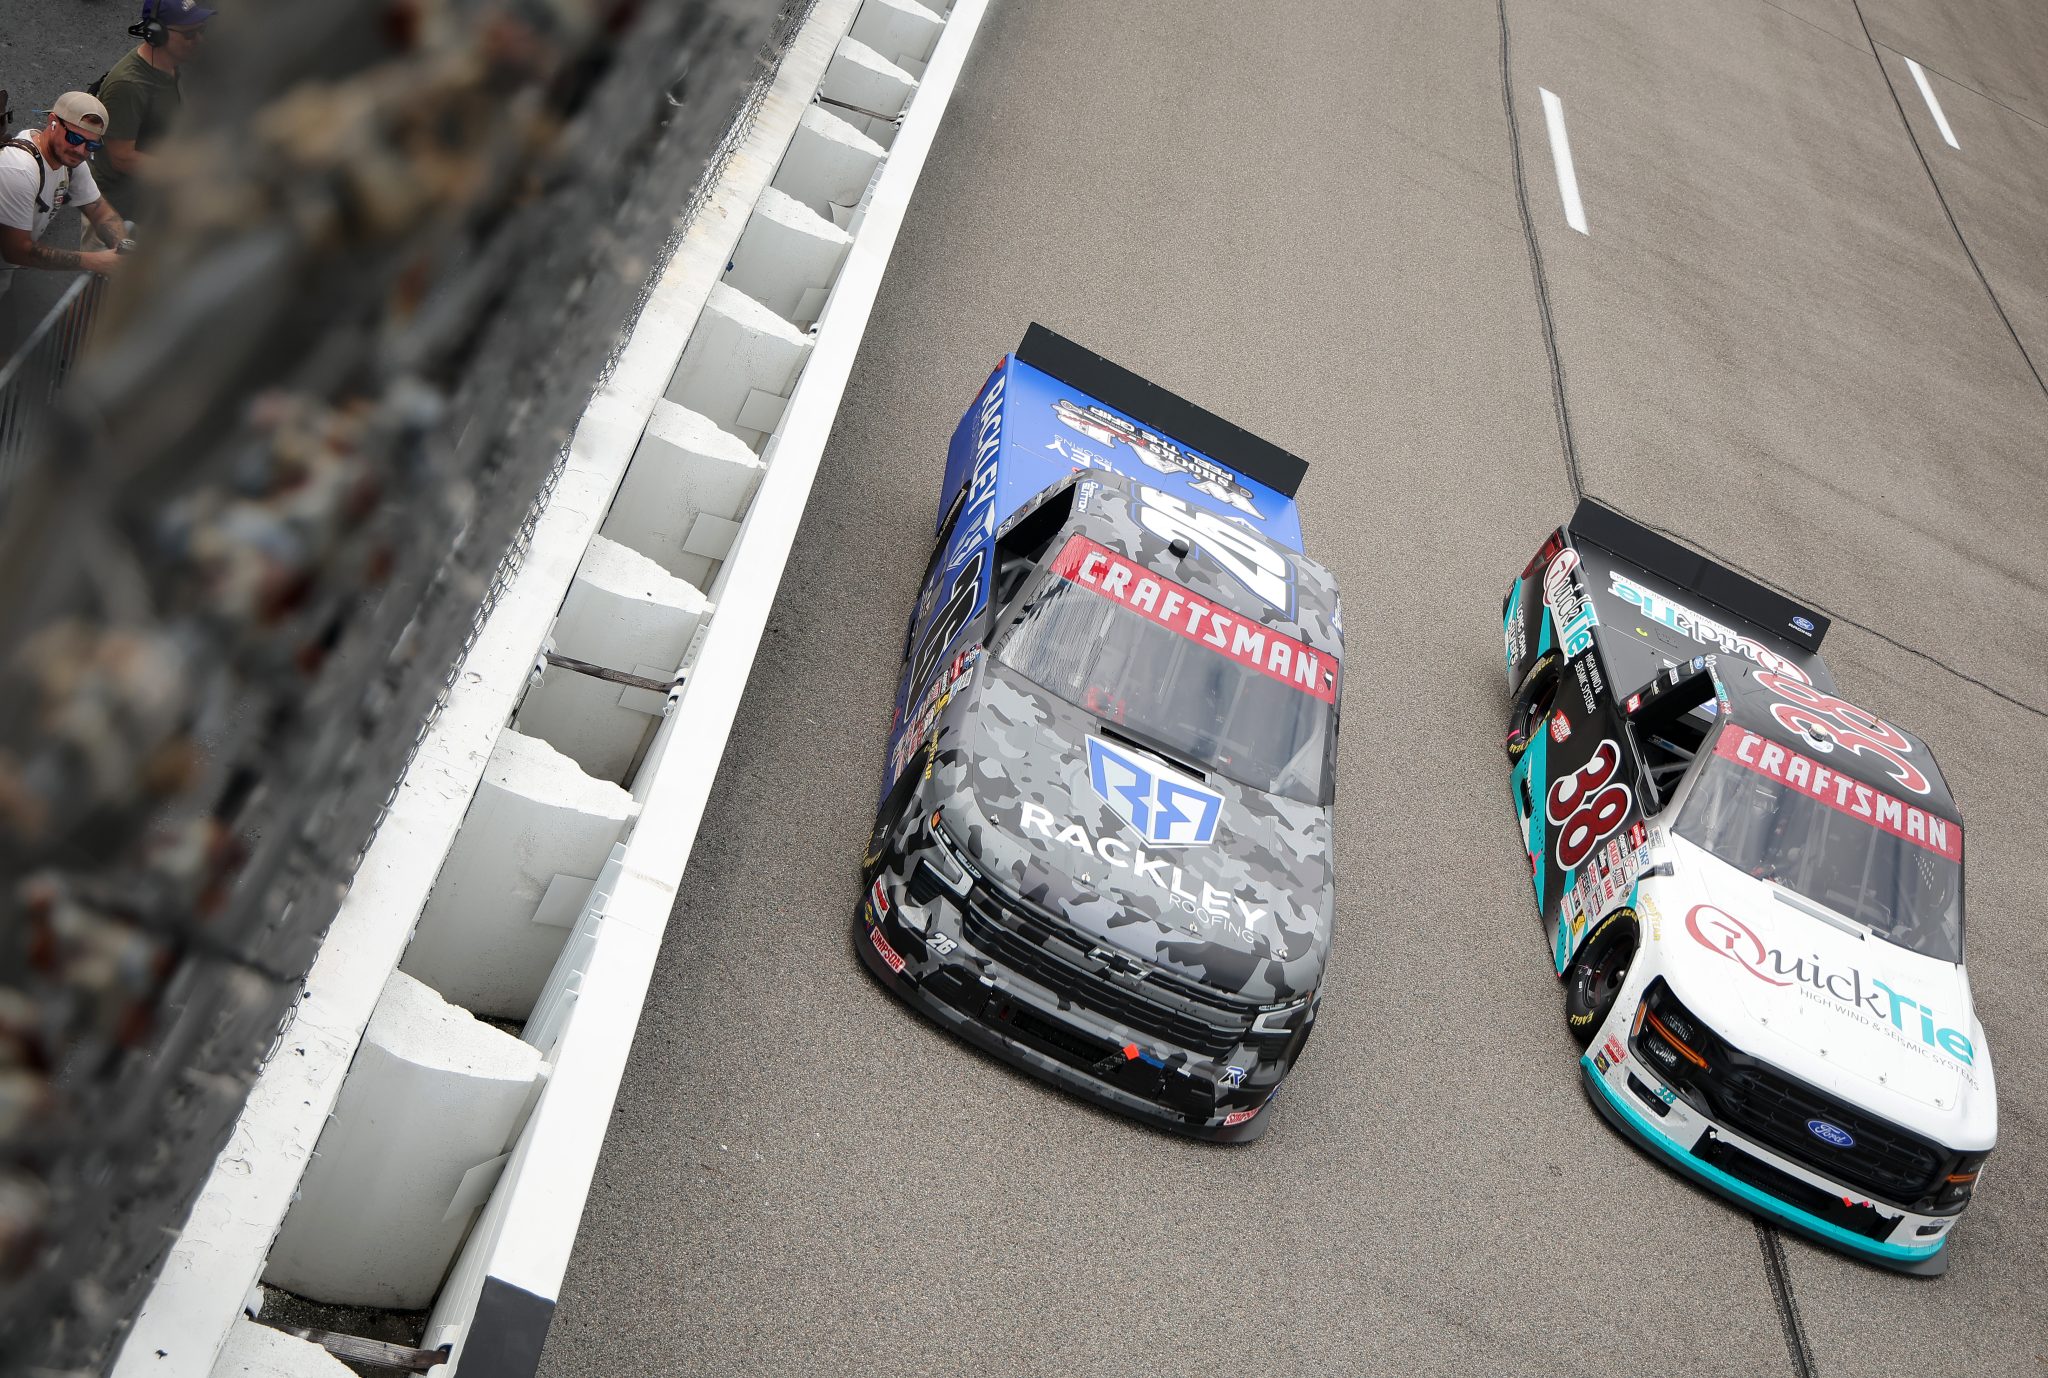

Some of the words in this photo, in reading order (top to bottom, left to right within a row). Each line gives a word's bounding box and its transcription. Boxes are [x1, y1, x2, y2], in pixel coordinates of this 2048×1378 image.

[1088, 406, 1136, 432] GRIP
[968, 375, 1006, 515] RACKLEY
[1054, 434, 1113, 466] ROOFING
[1140, 430, 1180, 456] THE
[1149, 443, 1229, 487] SHOCKS
[1186, 452, 1234, 481] FEEL
[1078, 551, 1319, 690] CRAFTSMAN
[1543, 548, 1597, 657] QuickTie
[1574, 660, 1588, 688] SEISMIC
[1581, 686, 1597, 714] SYSTEMS
[1585, 652, 1595, 668] HIGH
[1590, 668, 1602, 688] WIND
[1752, 670, 1931, 794] 38
[1546, 739, 1631, 871] 38
[1736, 735, 1947, 851] CRAFTSMAN
[1020, 801, 1267, 930] RACKLEY
[1638, 845, 1650, 866] SKF
[1169, 893, 1254, 944] ROOFING
[872, 928, 905, 973] SIMPSON
[926, 932, 959, 955] 26
[1685, 904, 1974, 1067] QuickTie
[1570, 1010, 1595, 1026] EAGLE
[1800, 986, 1832, 1009] HIGH
[1835, 1003, 1869, 1025] WIND
[1872, 1021, 1881, 1031] &
[1884, 1026, 1930, 1059] SEISMIC
[1932, 1055, 1980, 1091] SYSTEMS
[1607, 1033, 1628, 1060] SIMPSON
[1654, 1083, 1677, 1105] 38
[1811, 1121, 1850, 1145] Ford
